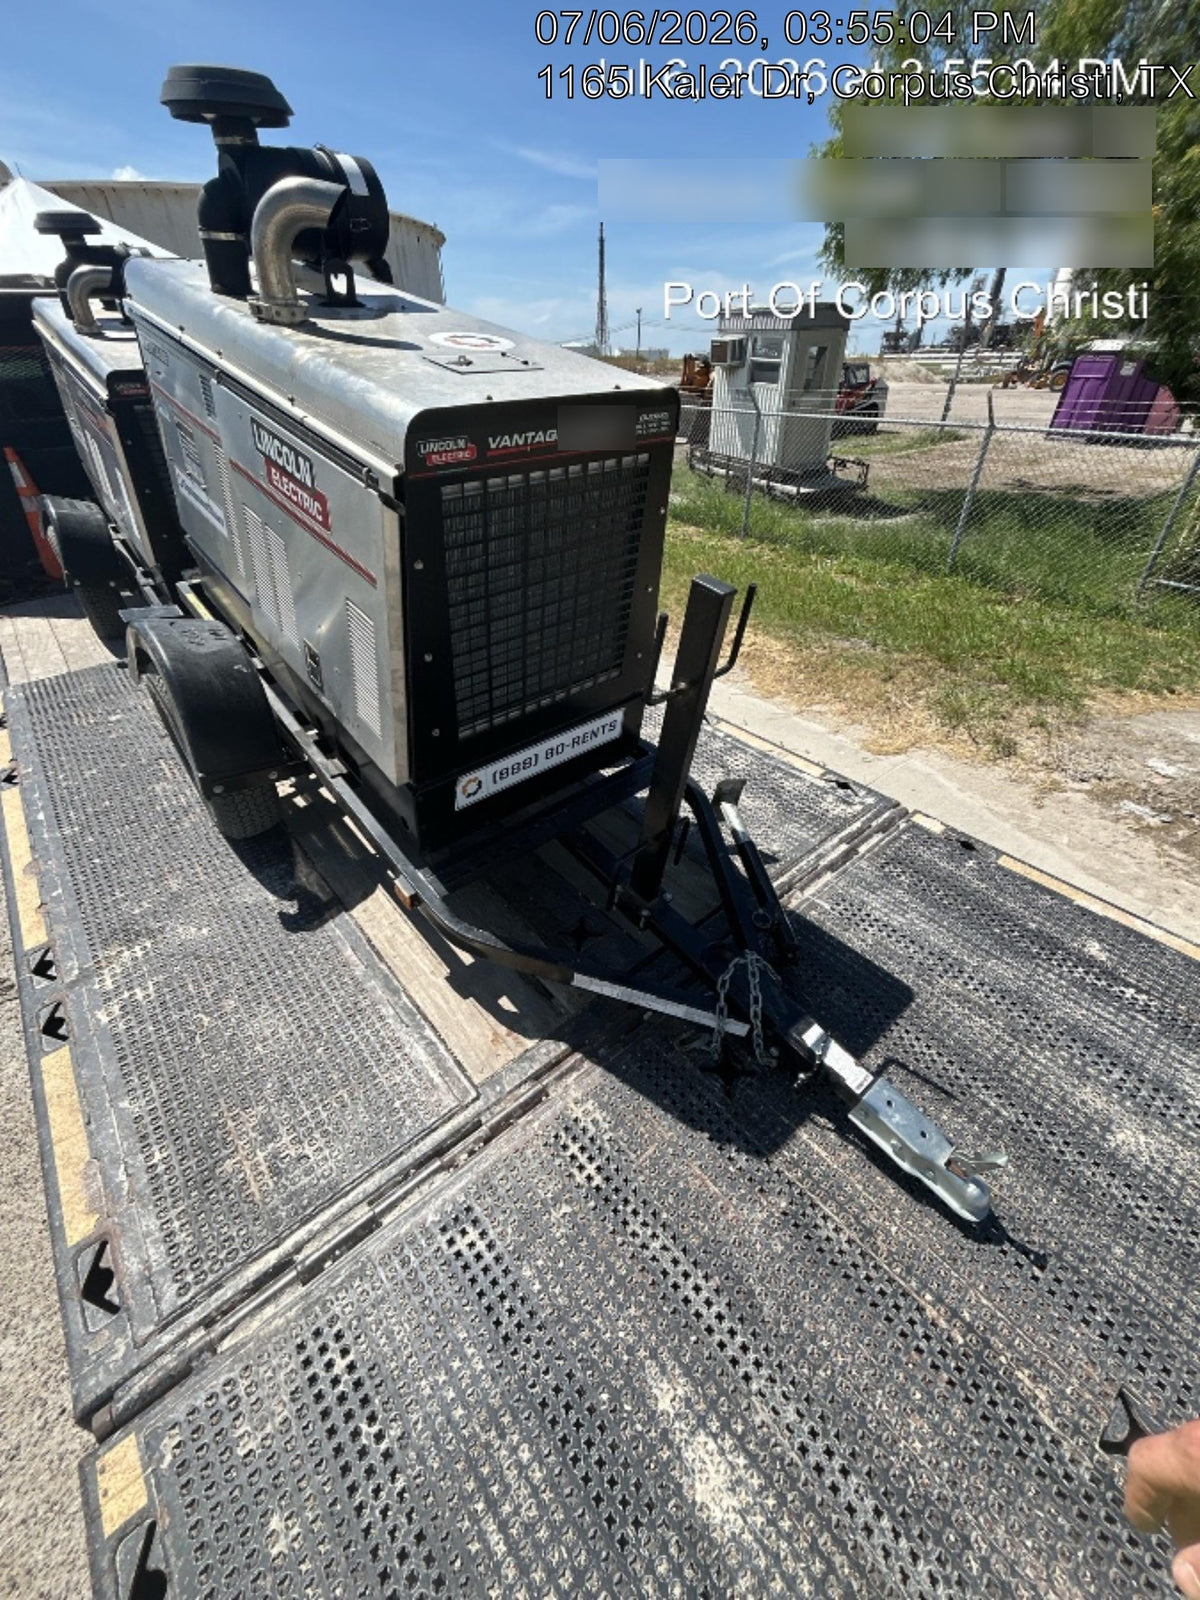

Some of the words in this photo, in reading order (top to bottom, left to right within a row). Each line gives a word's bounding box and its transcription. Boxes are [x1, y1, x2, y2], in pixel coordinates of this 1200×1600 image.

[420, 437, 467, 454] LINCOLN
[487, 429, 558, 449] VANTAG
[252, 422, 314, 489] LINCOLN
[270, 466, 323, 522] ELECTRIC
[492, 753, 539, 784] (888)
